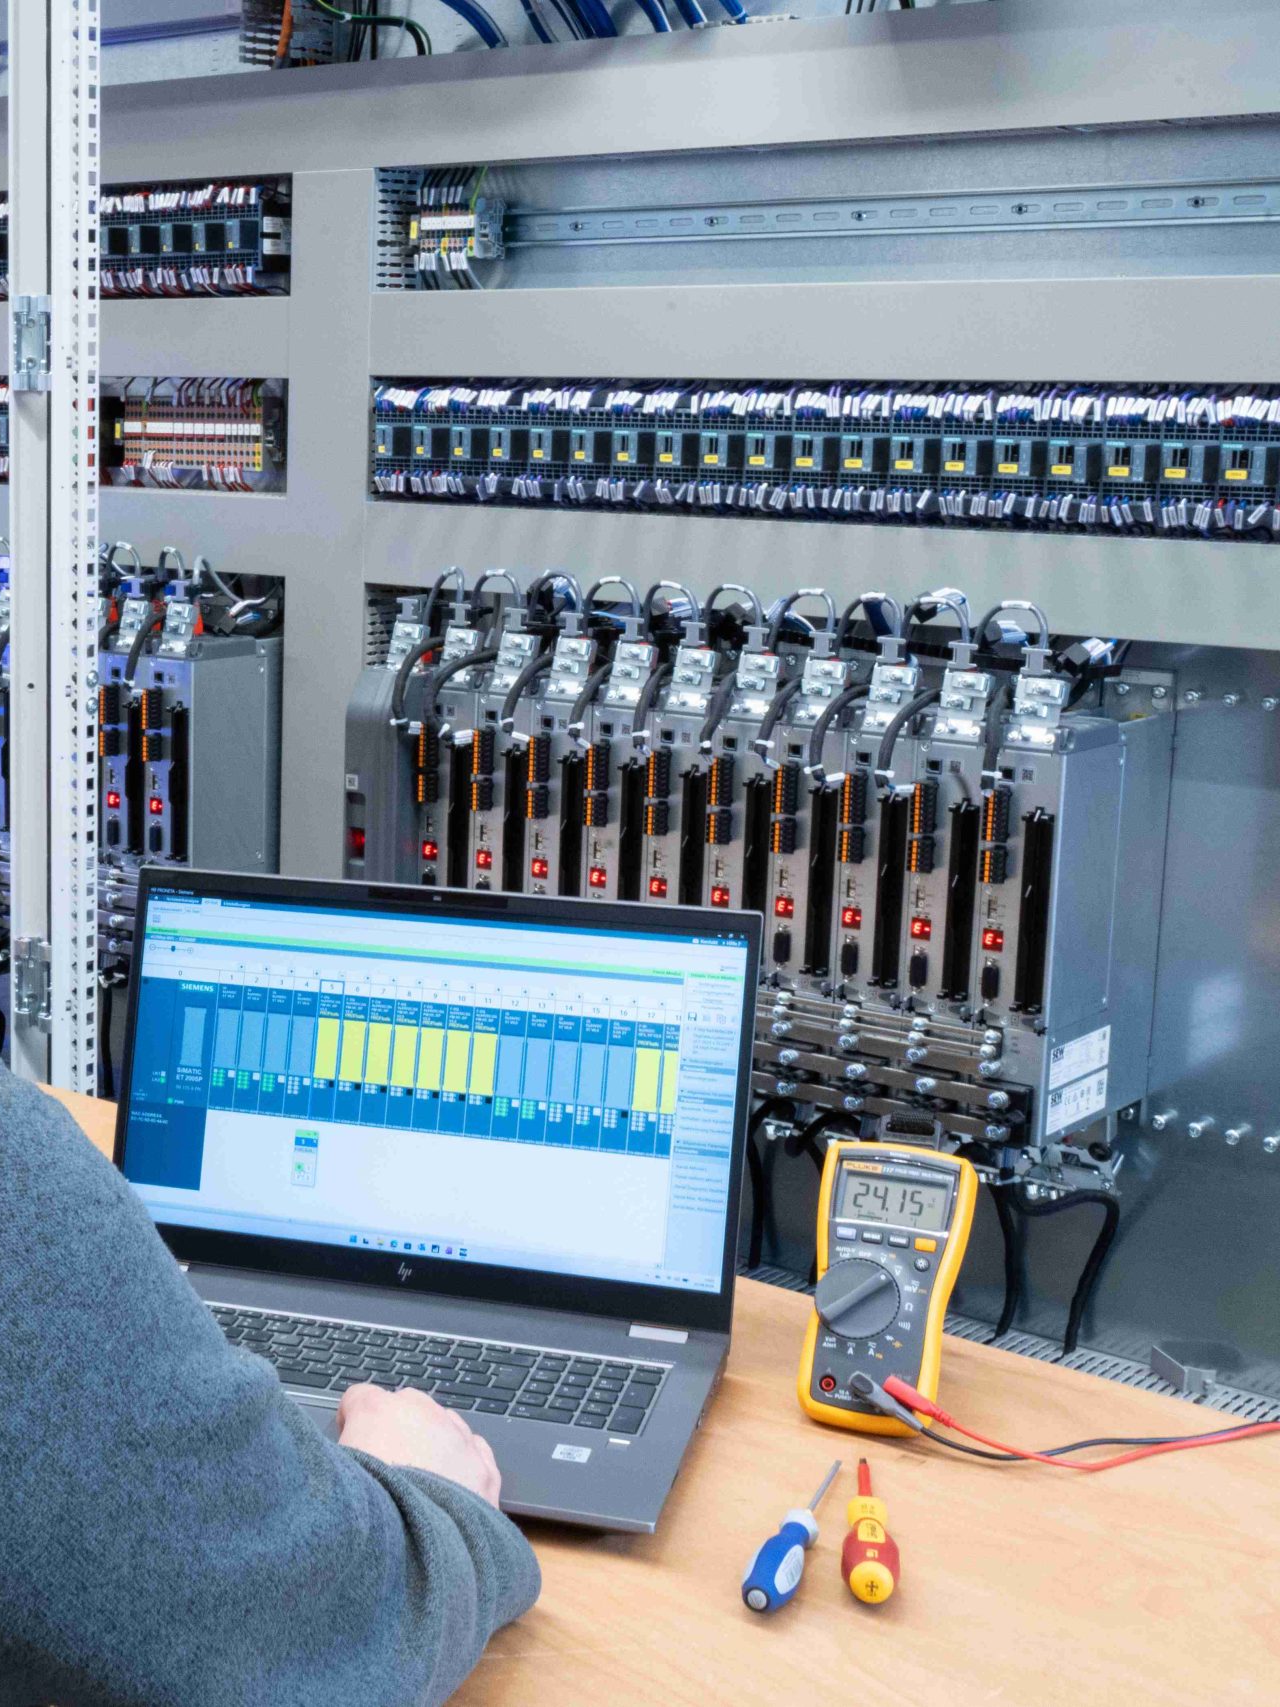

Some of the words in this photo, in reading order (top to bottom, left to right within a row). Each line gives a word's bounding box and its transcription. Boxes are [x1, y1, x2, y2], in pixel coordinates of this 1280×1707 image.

[181, 983, 214, 992] SIEMENS
[1052, 1047, 1064, 1060] SEW
[1051, 1091, 1063, 1105] SEW
[846, 1162, 879, 1172] FLUKE
[852, 1182, 924, 1216] 24.15
[398, 1262, 412, 1281] hp
